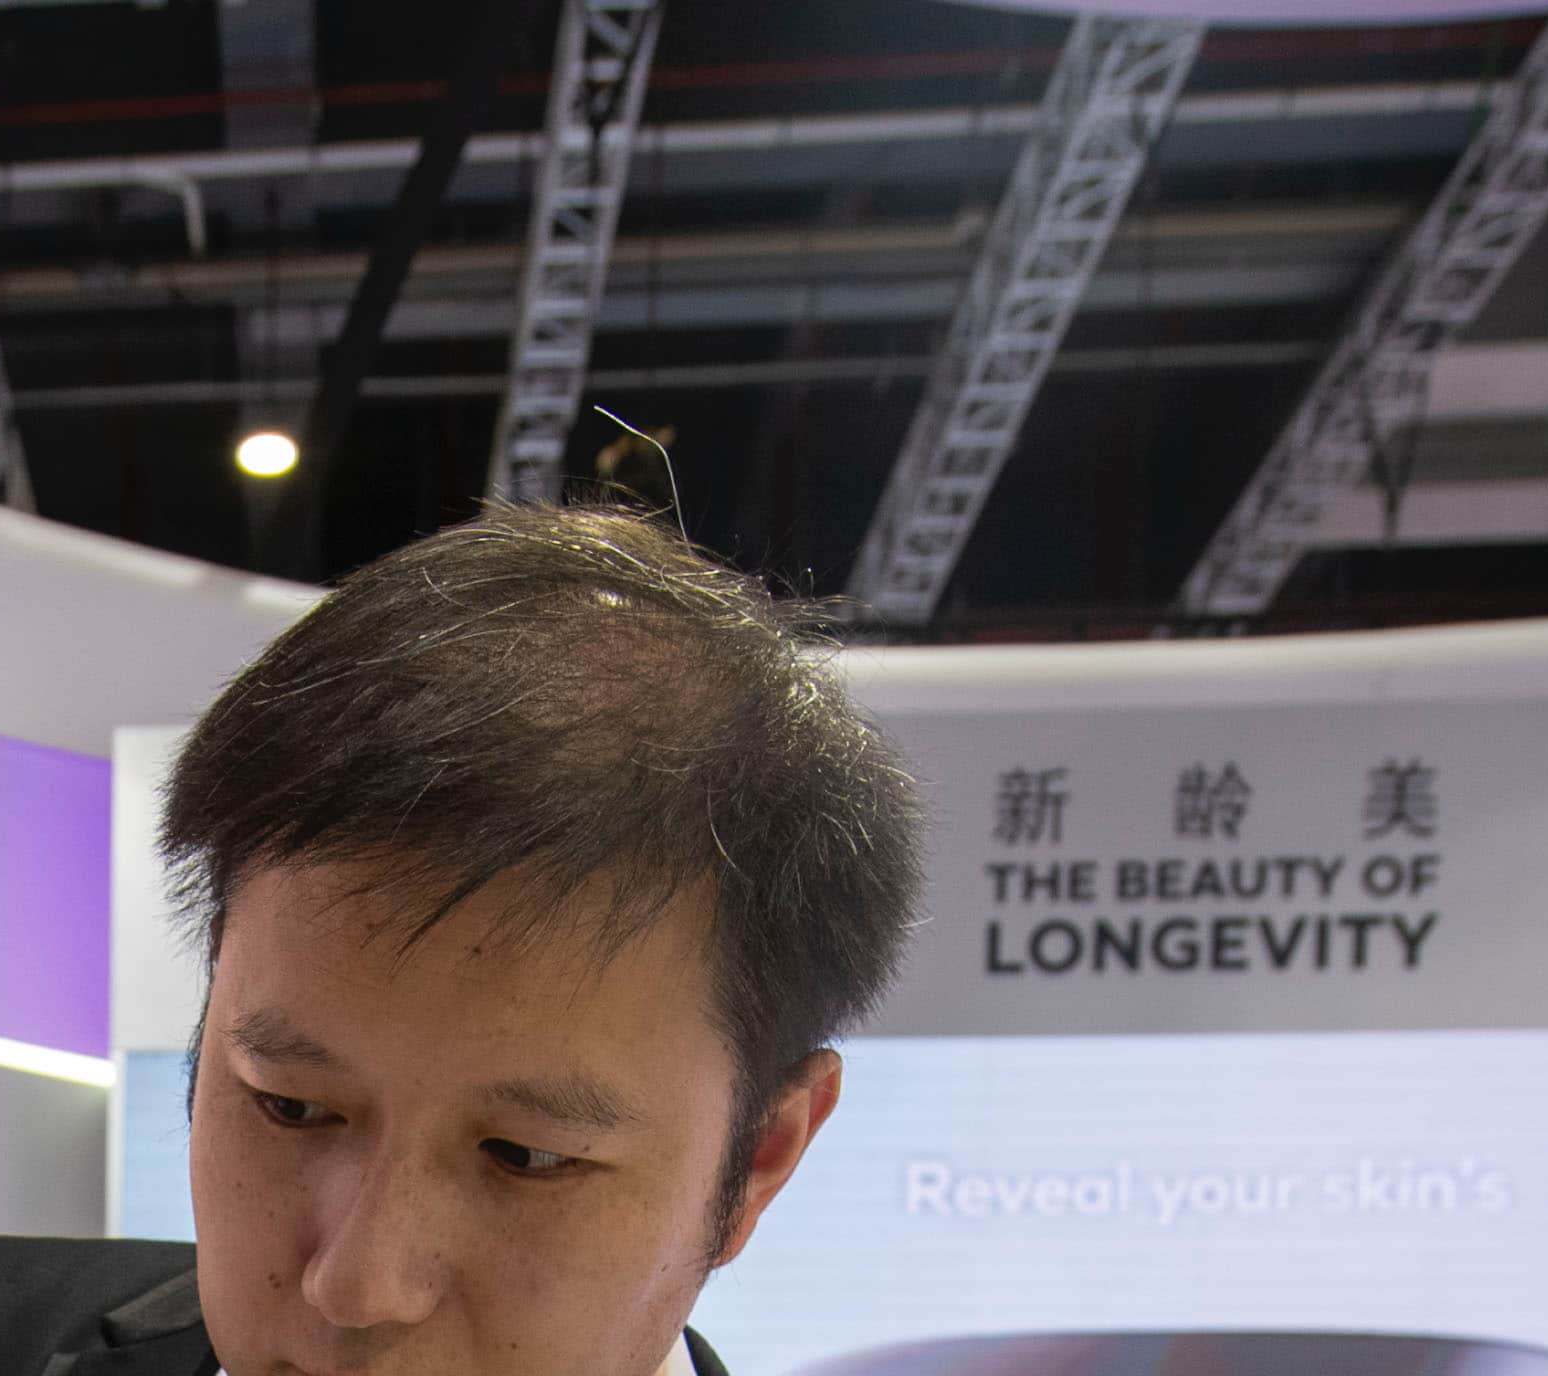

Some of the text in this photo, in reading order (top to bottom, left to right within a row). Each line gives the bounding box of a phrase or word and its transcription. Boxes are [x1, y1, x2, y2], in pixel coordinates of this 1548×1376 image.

[985, 852, 1441, 903] THE BEAUTY OF
[984, 911, 1439, 975] LONGEVITY
[906, 1157, 1512, 1228] Reveal your skin's
